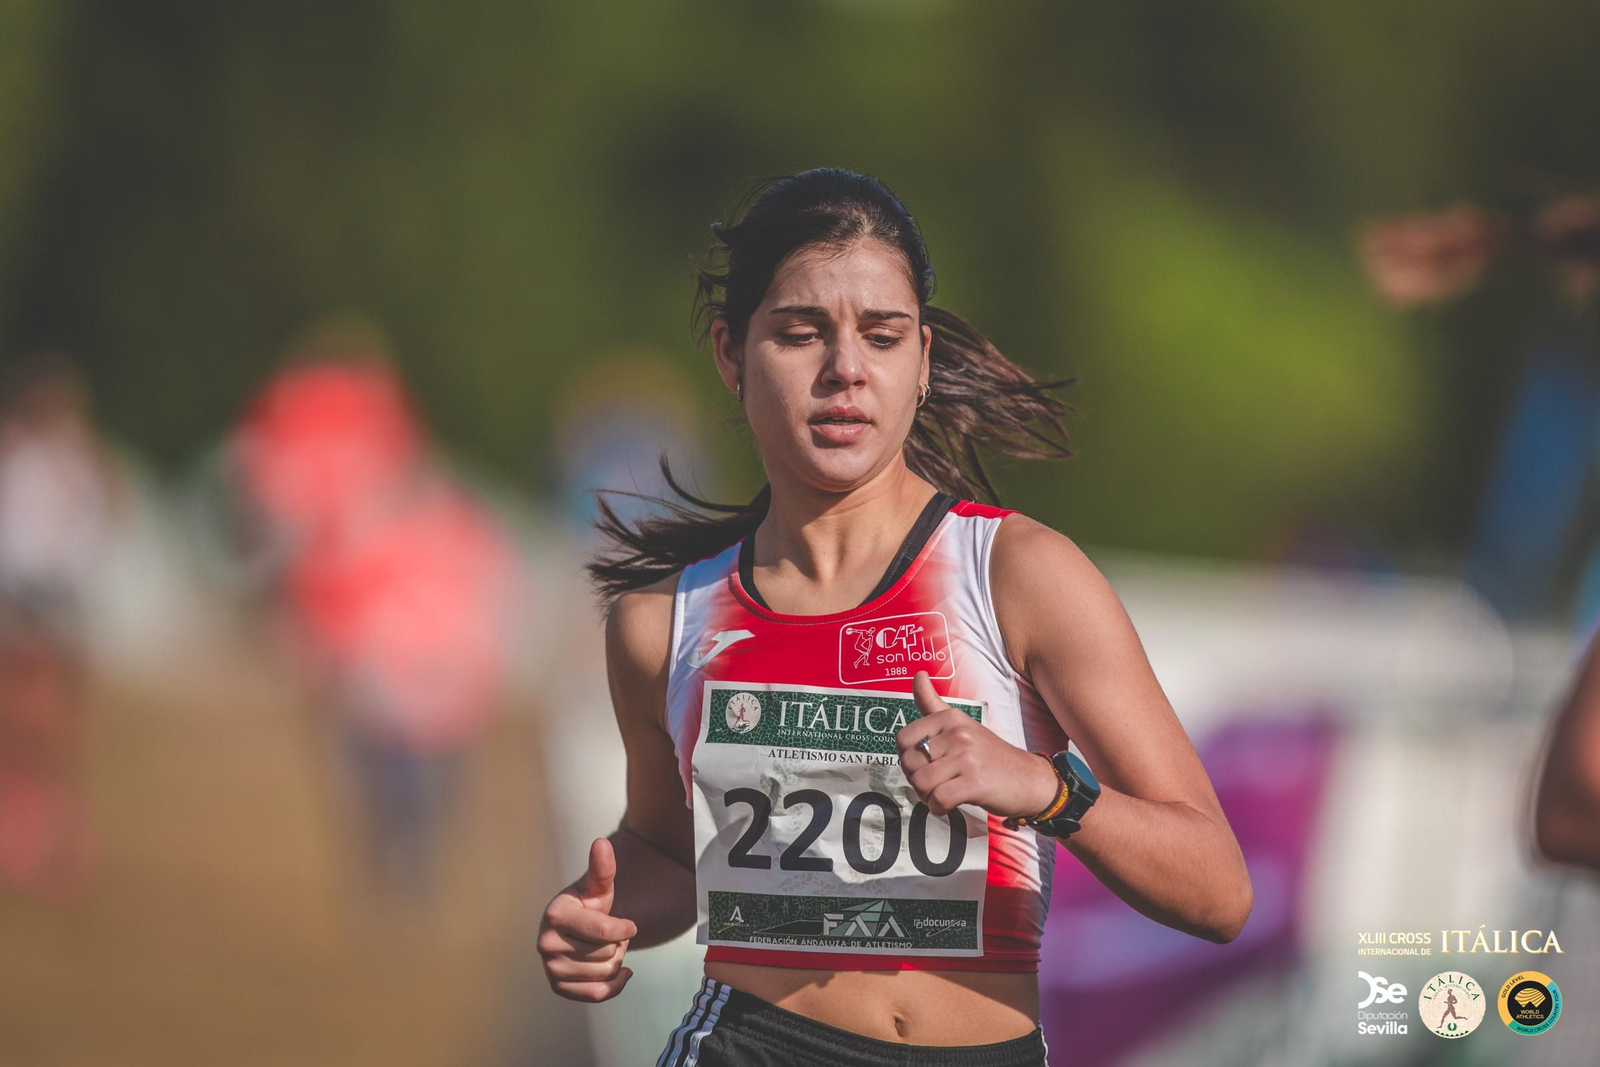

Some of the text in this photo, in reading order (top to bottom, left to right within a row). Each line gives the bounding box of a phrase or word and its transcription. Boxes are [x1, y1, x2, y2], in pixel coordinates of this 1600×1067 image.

[885, 667, 908, 677] 1988
[779, 696, 908, 735] ITÁLICA
[777, 729, 897, 743] INTERNATIONAL CROSS COUN
[768, 749, 837, 761] ATLETISMO
[839, 753, 863, 764] SAN
[723, 787, 968, 877] 2200
[749, 935, 913, 949] FEDERACIÓN ANDALUZA DE ATLETISMO
